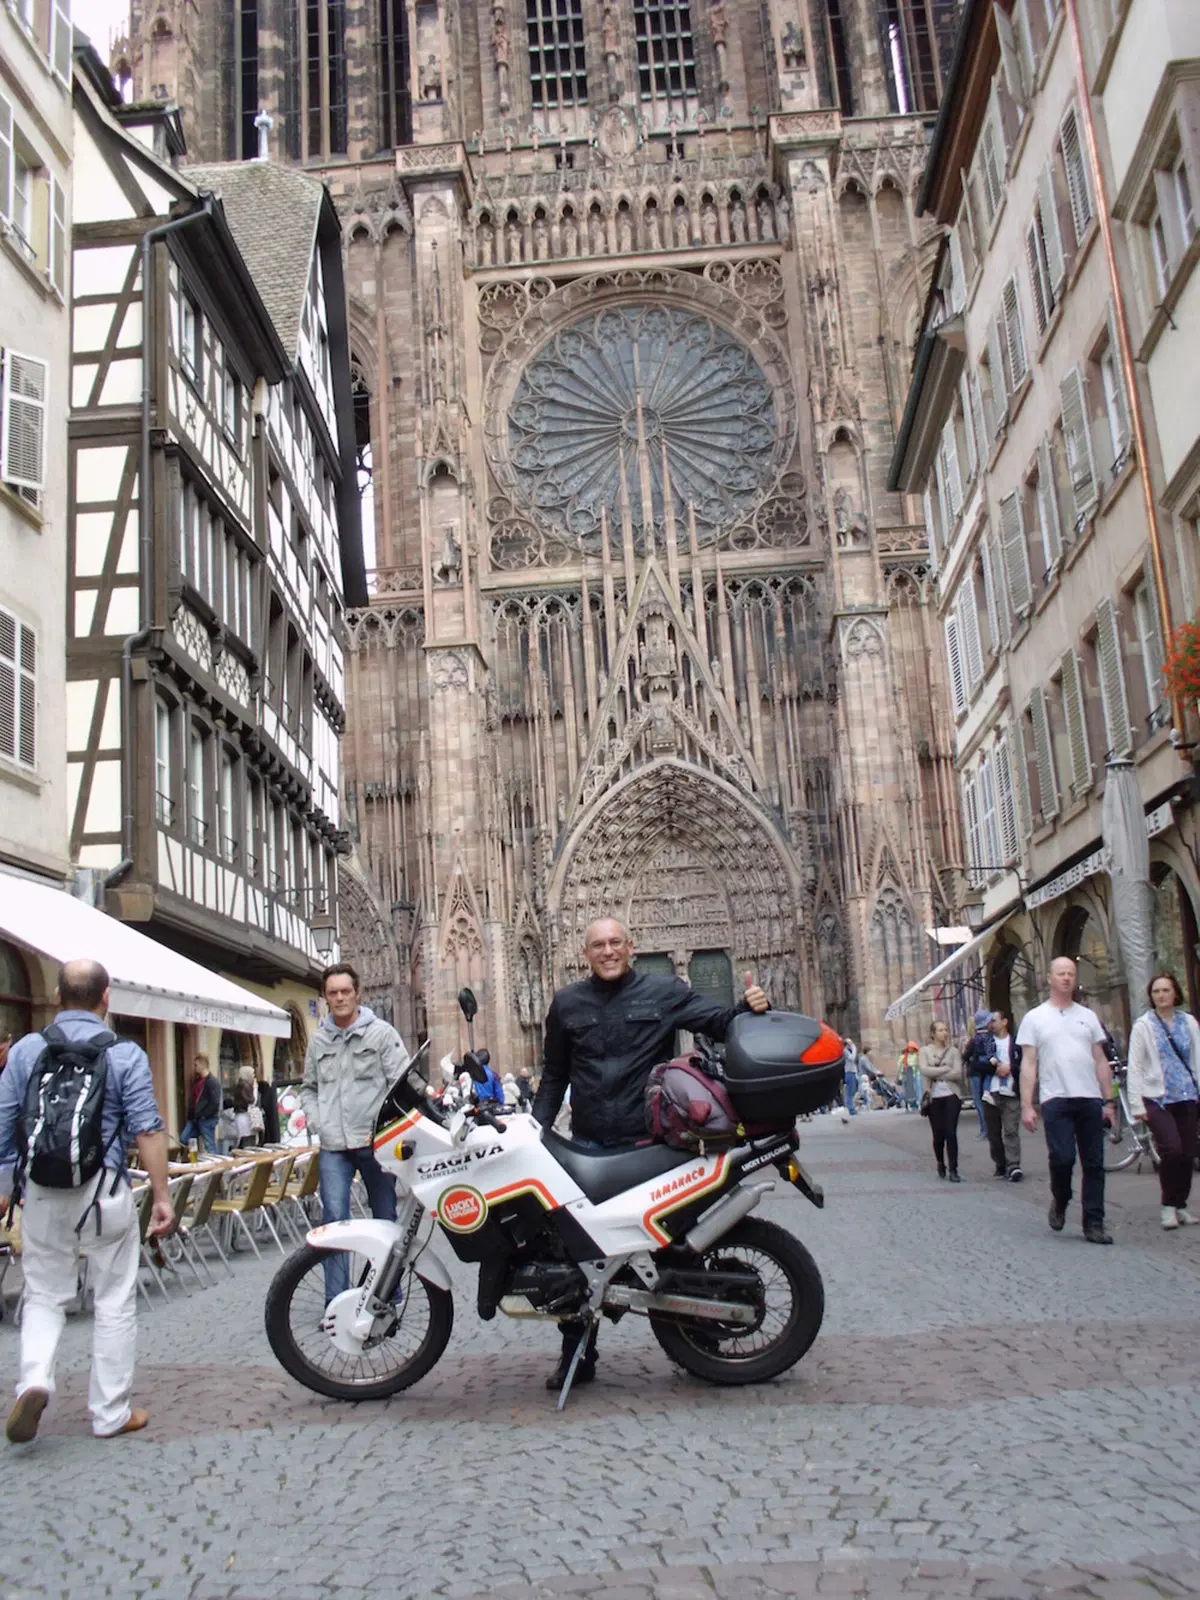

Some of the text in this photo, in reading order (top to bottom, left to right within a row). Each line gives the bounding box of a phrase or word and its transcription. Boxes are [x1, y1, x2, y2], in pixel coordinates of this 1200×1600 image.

[417, 1144, 504, 1173] CAGIVA
[741, 1143, 791, 1172] LUCKY EXPLORER
[420, 1164, 468, 1181] CRISTIANI
[445, 1196, 475, 1213] LUCKY
[402, 1202, 425, 1247] CAGIV
